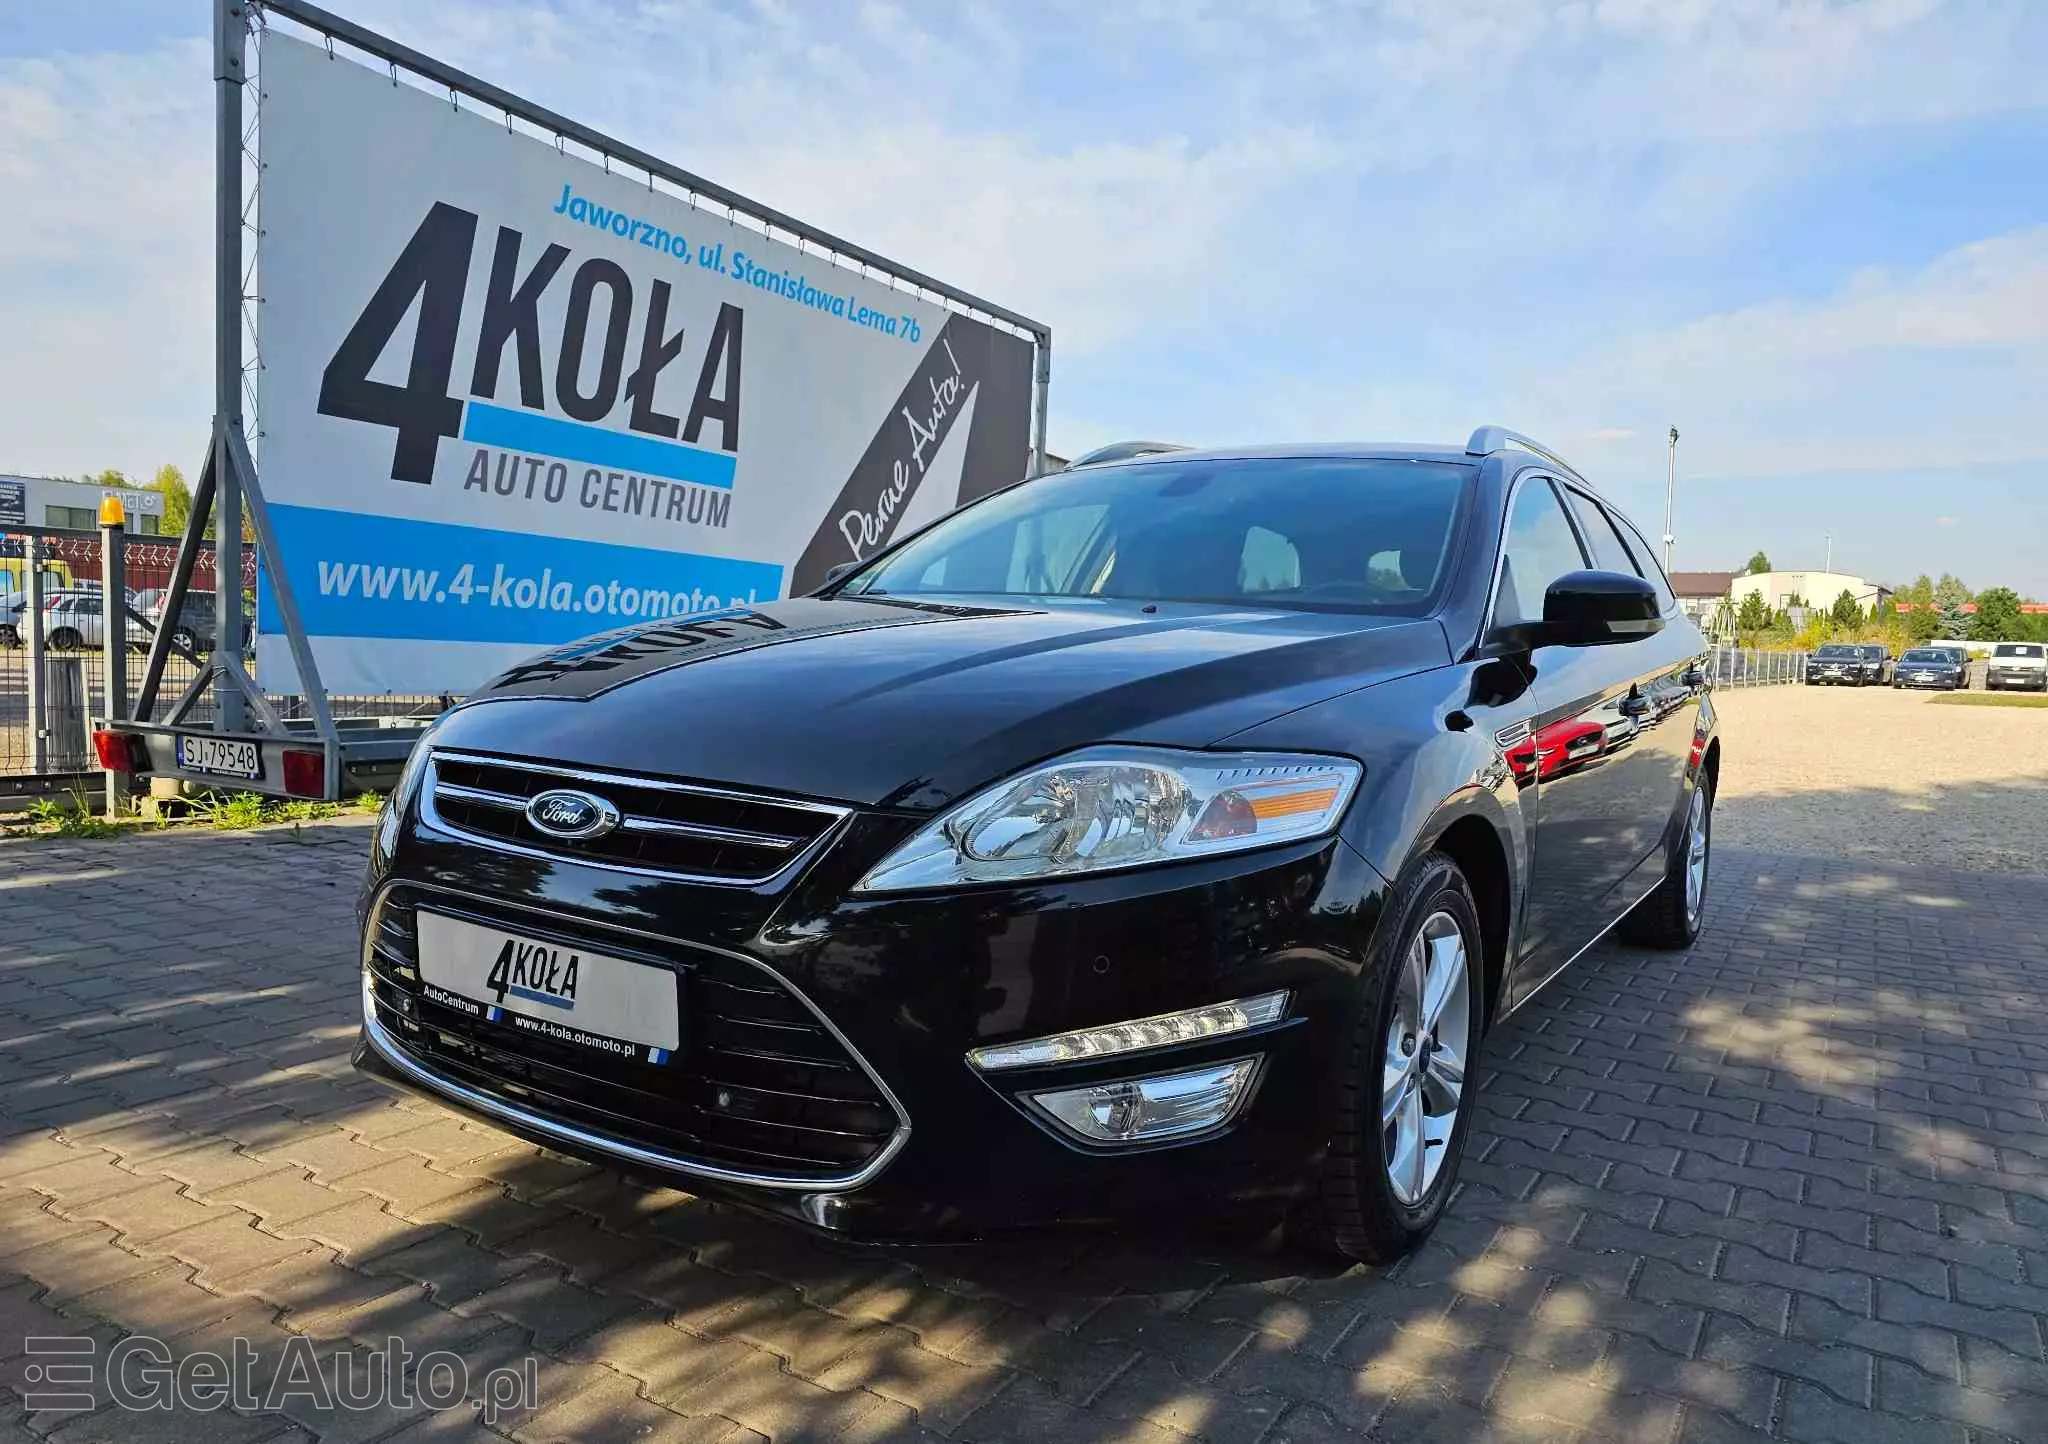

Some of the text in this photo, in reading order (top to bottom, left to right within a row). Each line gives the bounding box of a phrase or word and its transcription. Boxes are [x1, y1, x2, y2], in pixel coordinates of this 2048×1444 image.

[553, 184, 921, 343] Jaworzno, ul. Stanisława Lema 7b
[902, 338, 966, 472] Auta!
[463, 449, 732, 529] AUTO CENTRUM
[542, 798, 584, 825] Ford
[423, 984, 479, 1016] AutoCentrum
